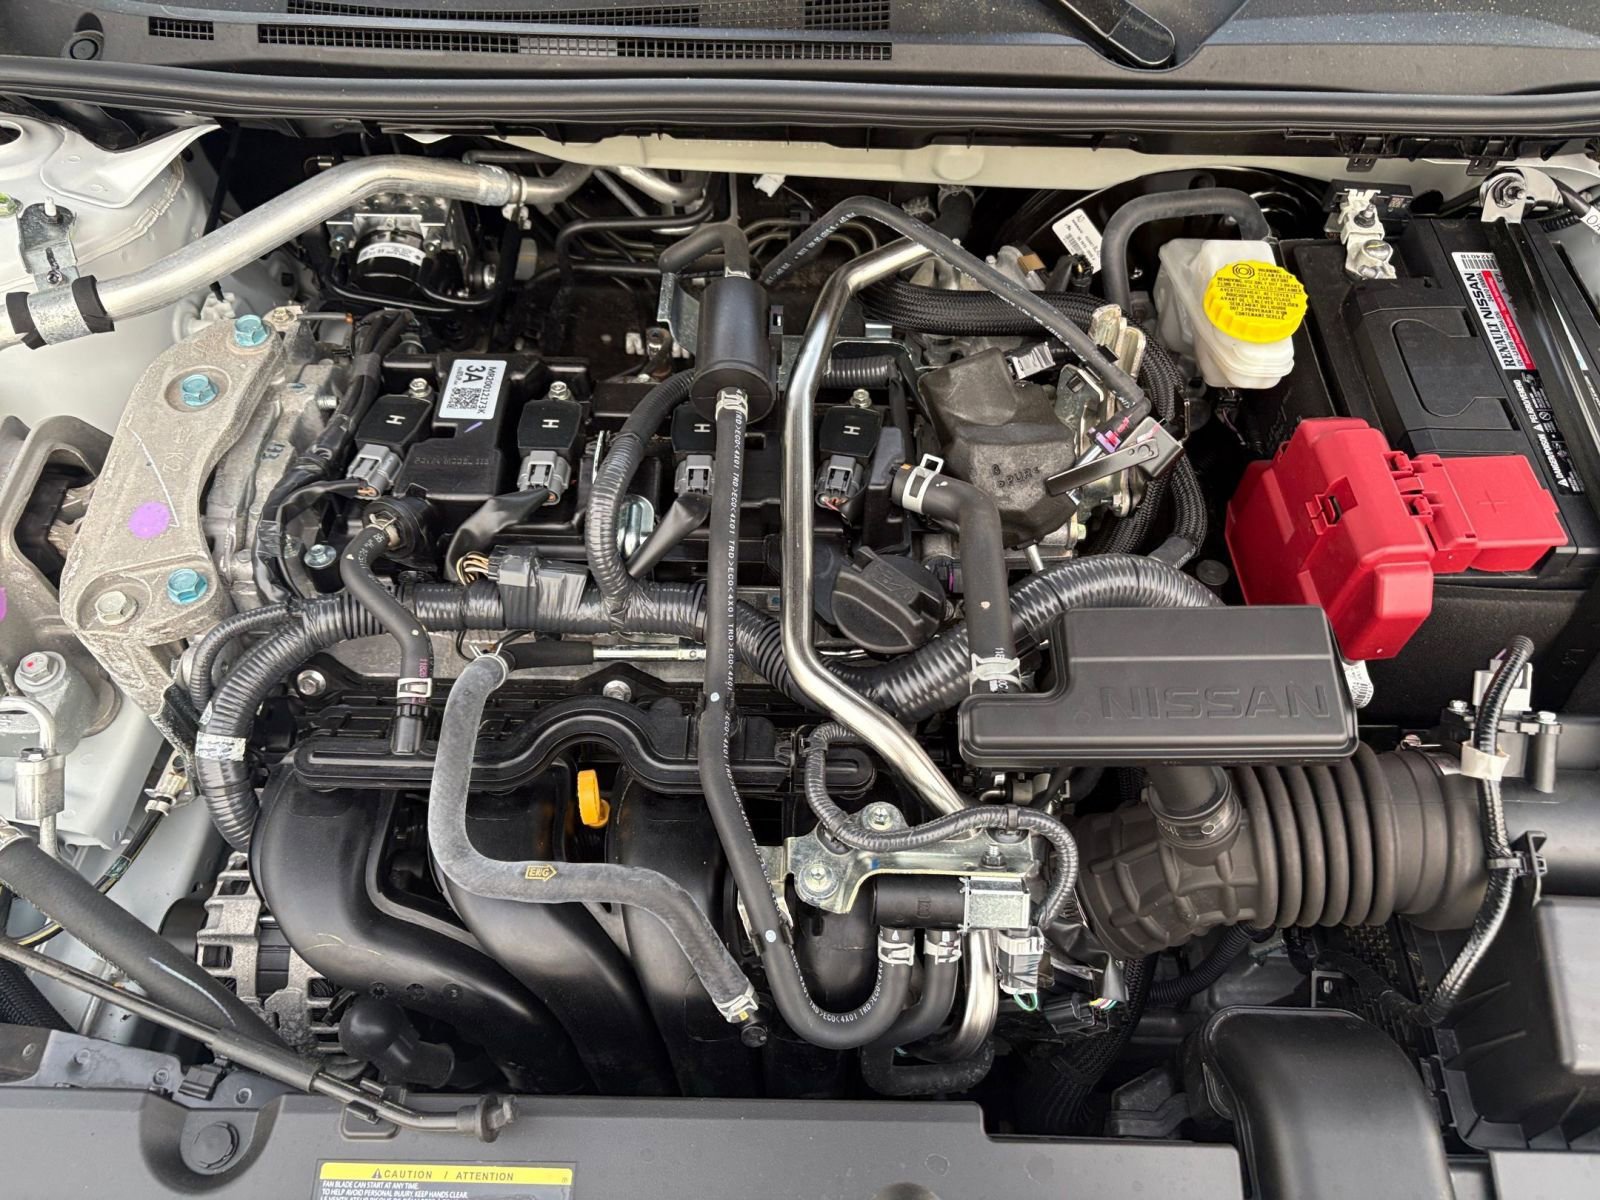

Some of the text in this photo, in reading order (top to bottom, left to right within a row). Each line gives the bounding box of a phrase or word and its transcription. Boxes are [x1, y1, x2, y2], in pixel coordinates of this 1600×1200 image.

[1464, 272, 1516, 367] RENAULT NISSAN
[463, 365, 486, 383] 3A
[386, 414, 405, 425] H
[542, 419, 560, 428] H
[694, 424, 711, 432] H
[843, 425, 860, 435] H
[1100, 685, 1330, 720] NISSAN
[529, 868, 549, 877] ENG
[384, 1170, 432, 1179] CAUTION
[456, 1172, 514, 1181] ATTENTION
[322, 1180, 334, 1188] FAN
